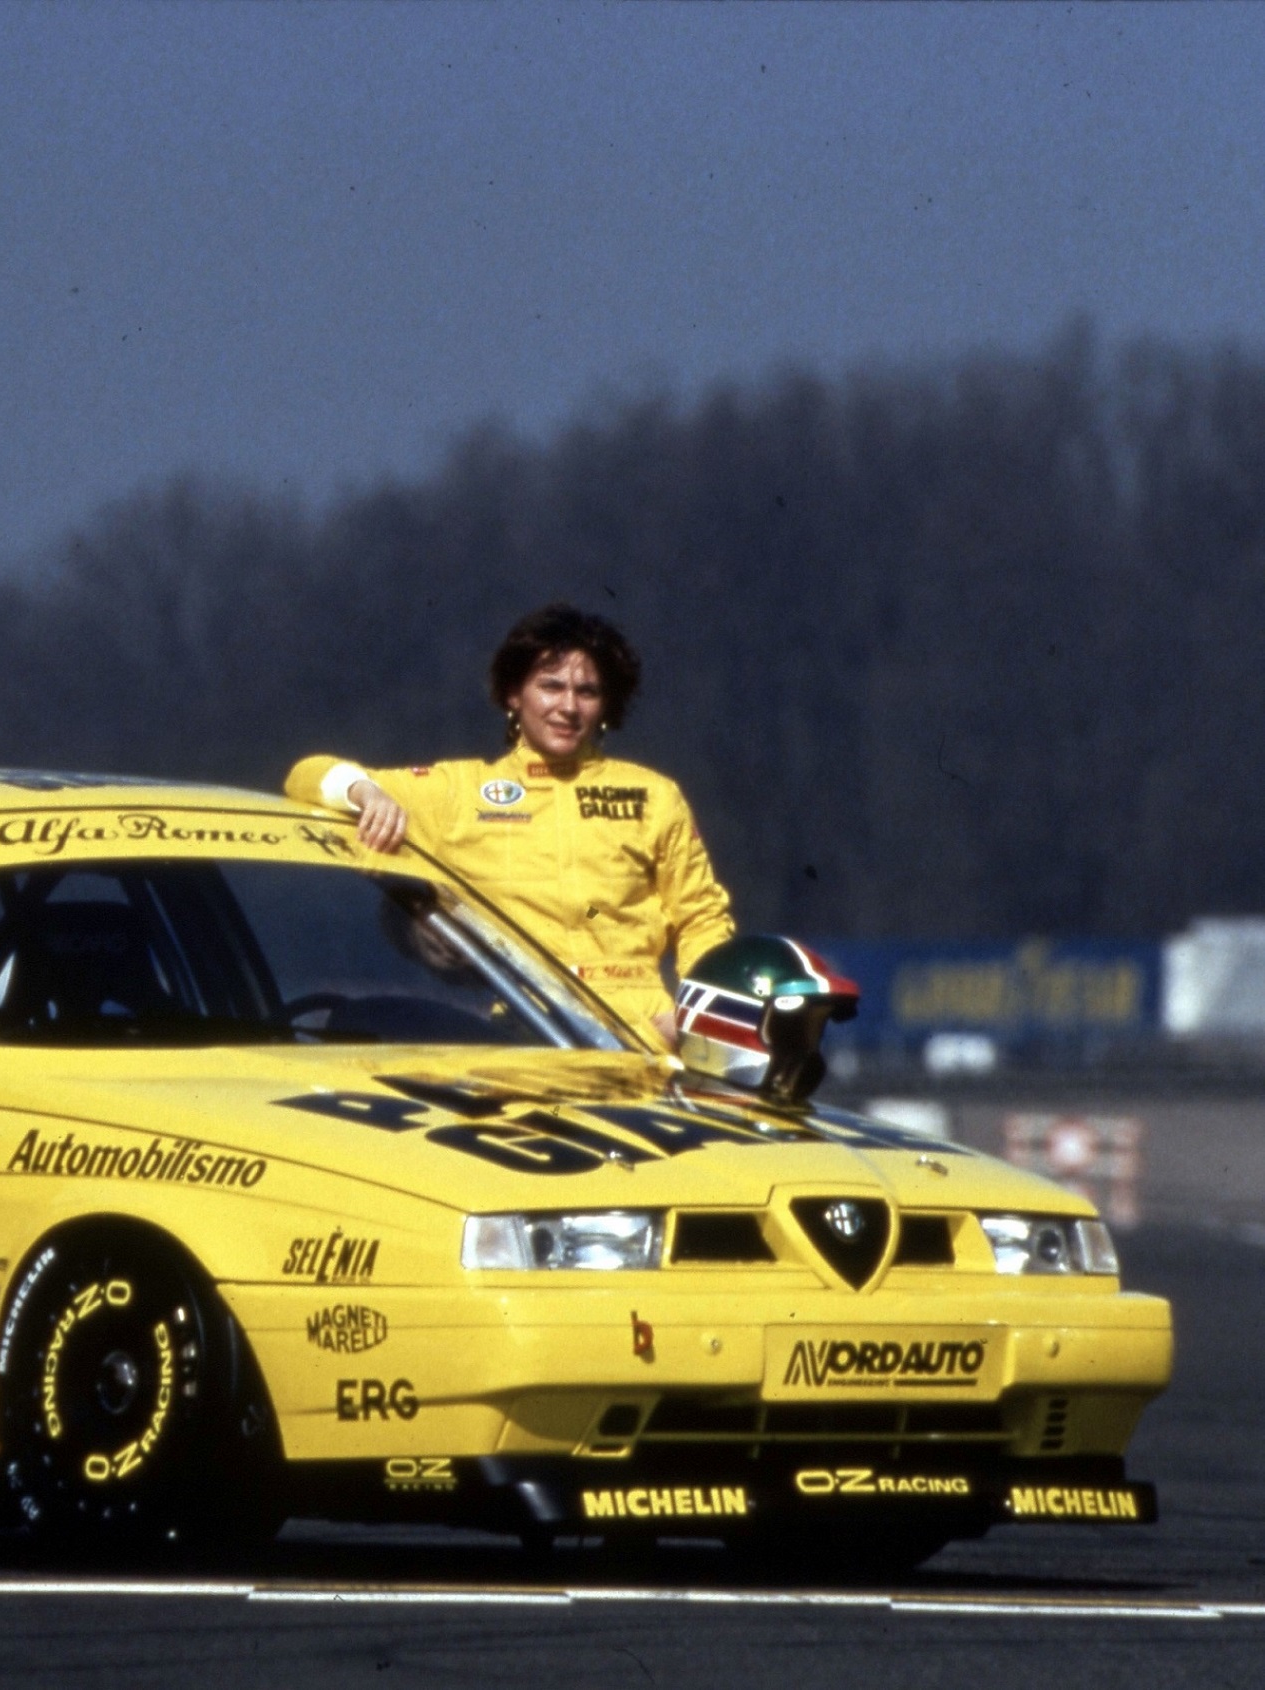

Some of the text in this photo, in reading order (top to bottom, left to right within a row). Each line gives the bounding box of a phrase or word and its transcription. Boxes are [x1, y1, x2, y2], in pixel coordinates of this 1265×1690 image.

[576, 786, 648, 803] PAGINE
[579, 802, 644, 821] GIALLE
[7, 1128, 267, 1188] Automobilismo
[43, 1308, 76, 1438] RACING
[140, 1322, 173, 1453] RACING
[337, 1379, 420, 1422] ERG
[877, 1476, 969, 1494] RACING
[582, 1488, 747, 1518] MICHELIN
[1012, 1486, 1137, 1518] MICHELIN
